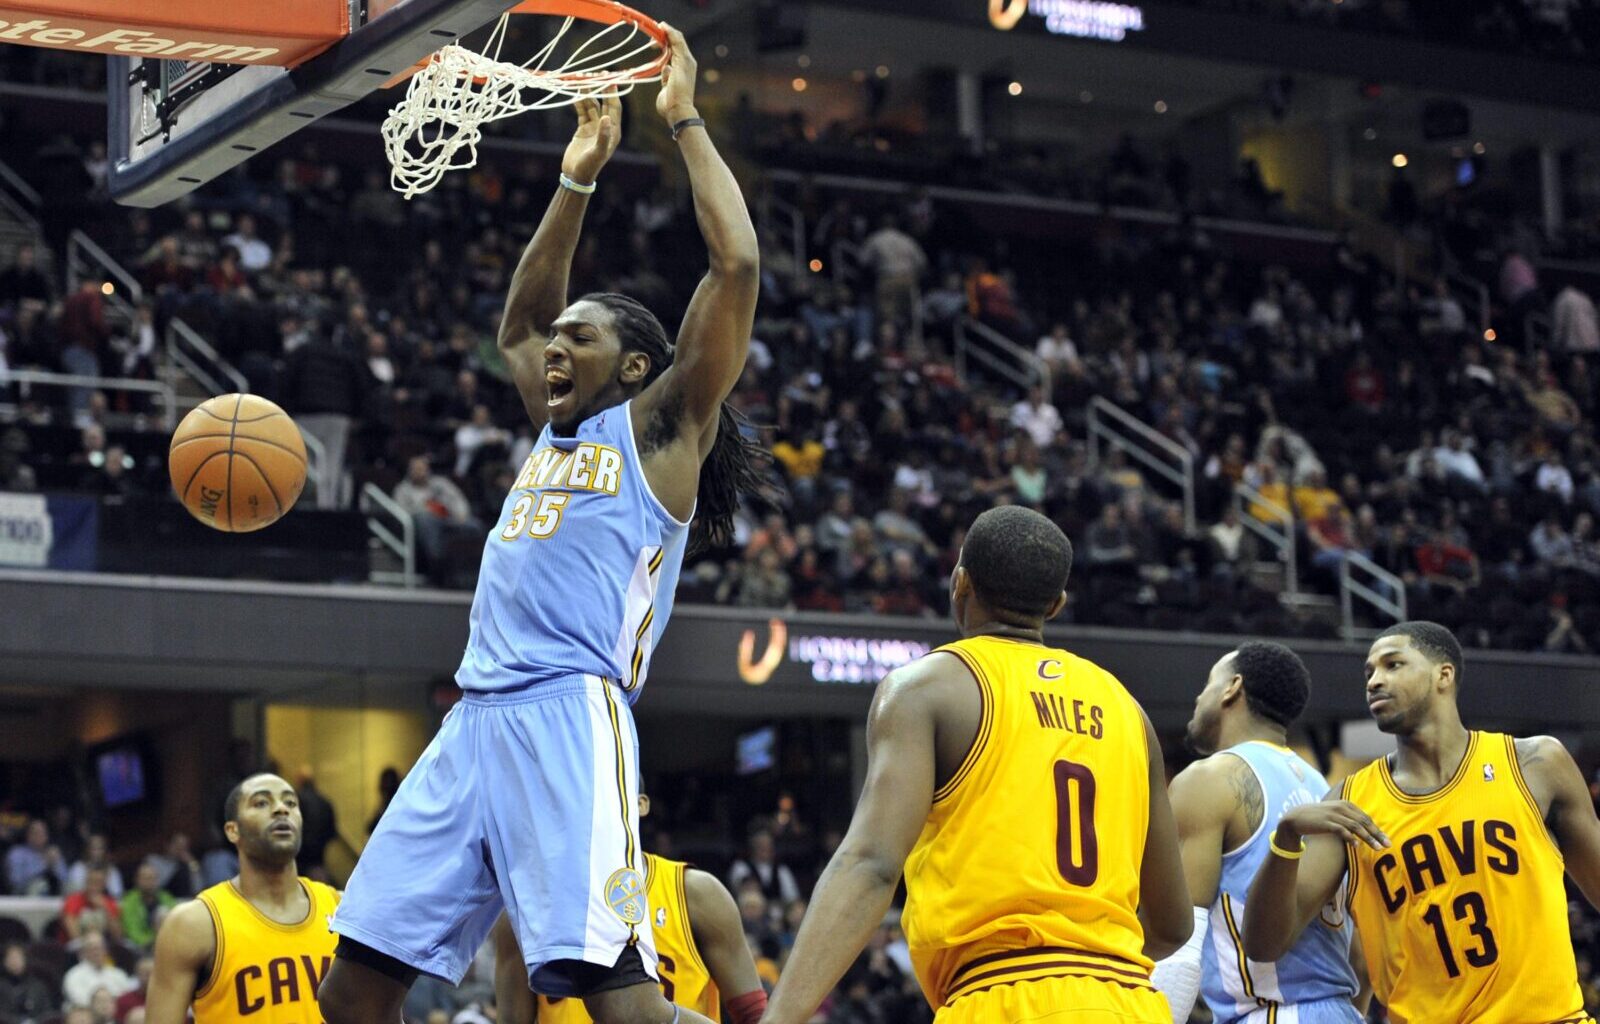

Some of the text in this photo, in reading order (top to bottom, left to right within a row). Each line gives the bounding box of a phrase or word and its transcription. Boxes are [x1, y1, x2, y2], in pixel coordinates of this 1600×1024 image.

[75, 28, 280, 61] Farm
[501, 491, 571, 541] 35
[1038, 659, 1062, 680] C
[1030, 691, 1104, 740] MILES
[1053, 759, 1099, 888] 0
[1373, 819, 1520, 914] CAVS
[1422, 891, 1499, 979] 13
